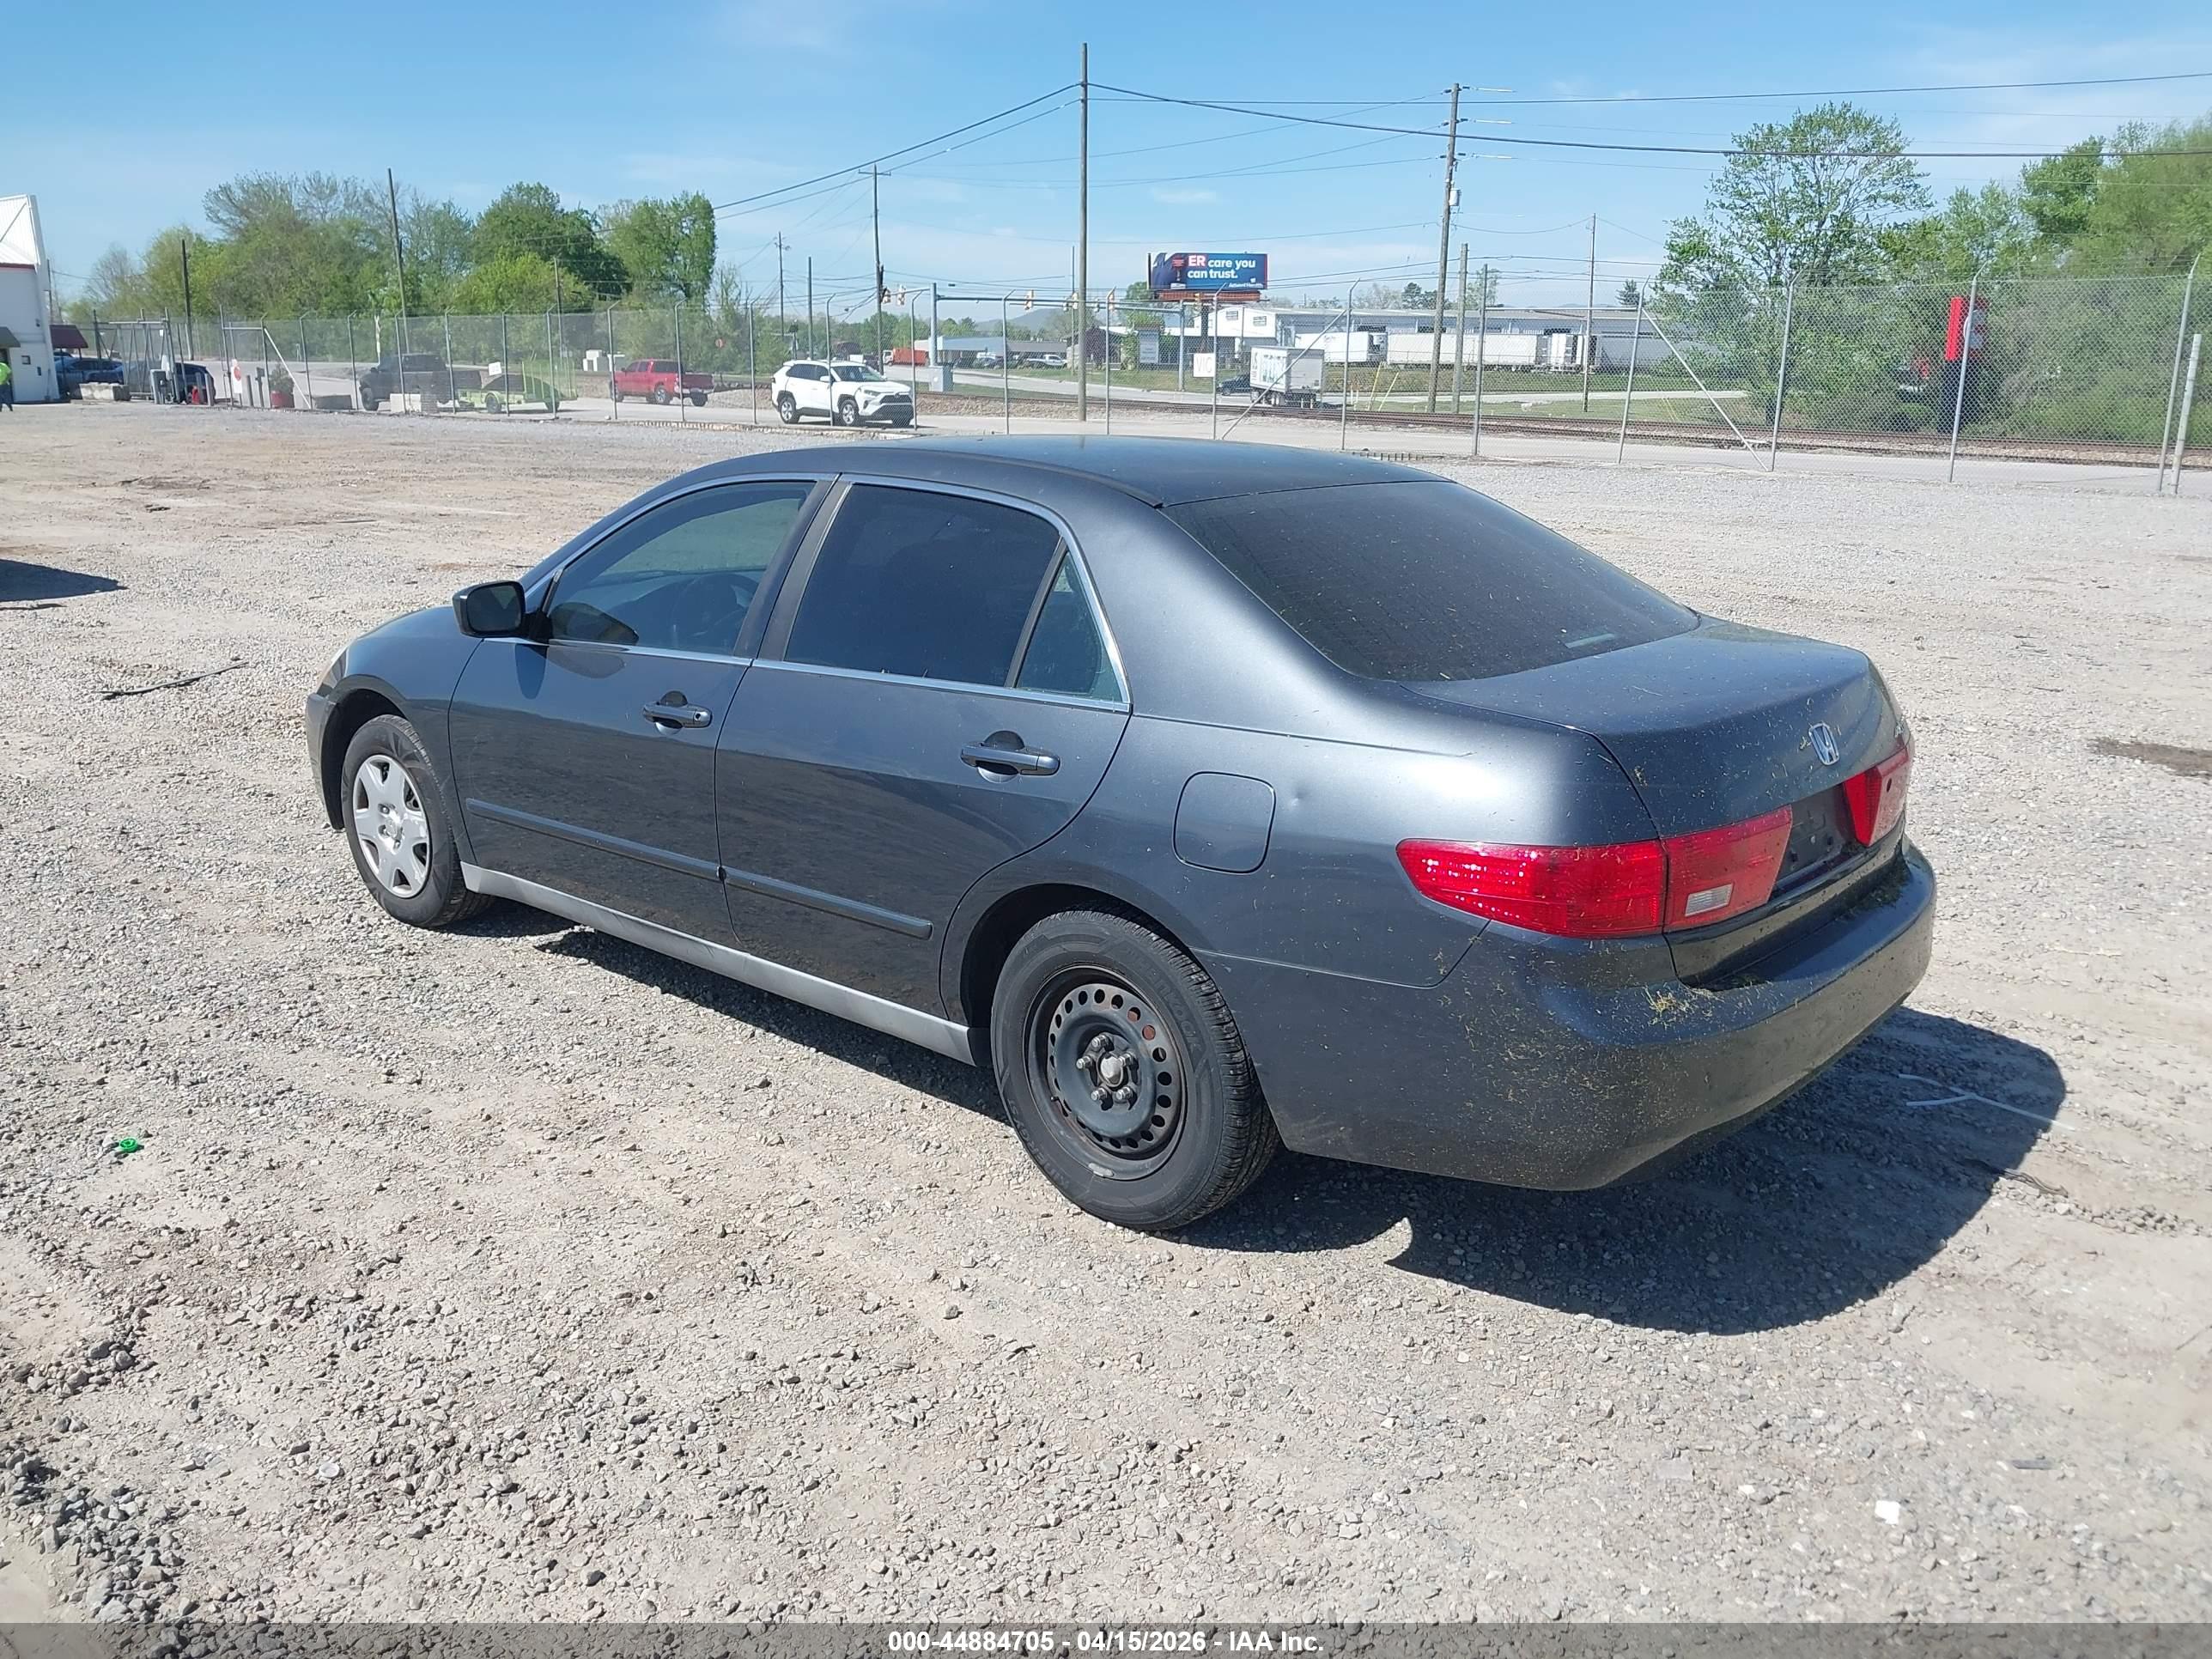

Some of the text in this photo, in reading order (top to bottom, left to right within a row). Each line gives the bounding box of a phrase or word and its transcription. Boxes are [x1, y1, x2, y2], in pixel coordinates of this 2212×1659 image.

[1188, 255, 1206, 266] ER
[1235, 260, 1255, 270] you
[1188, 270, 1238, 279] can trust.
